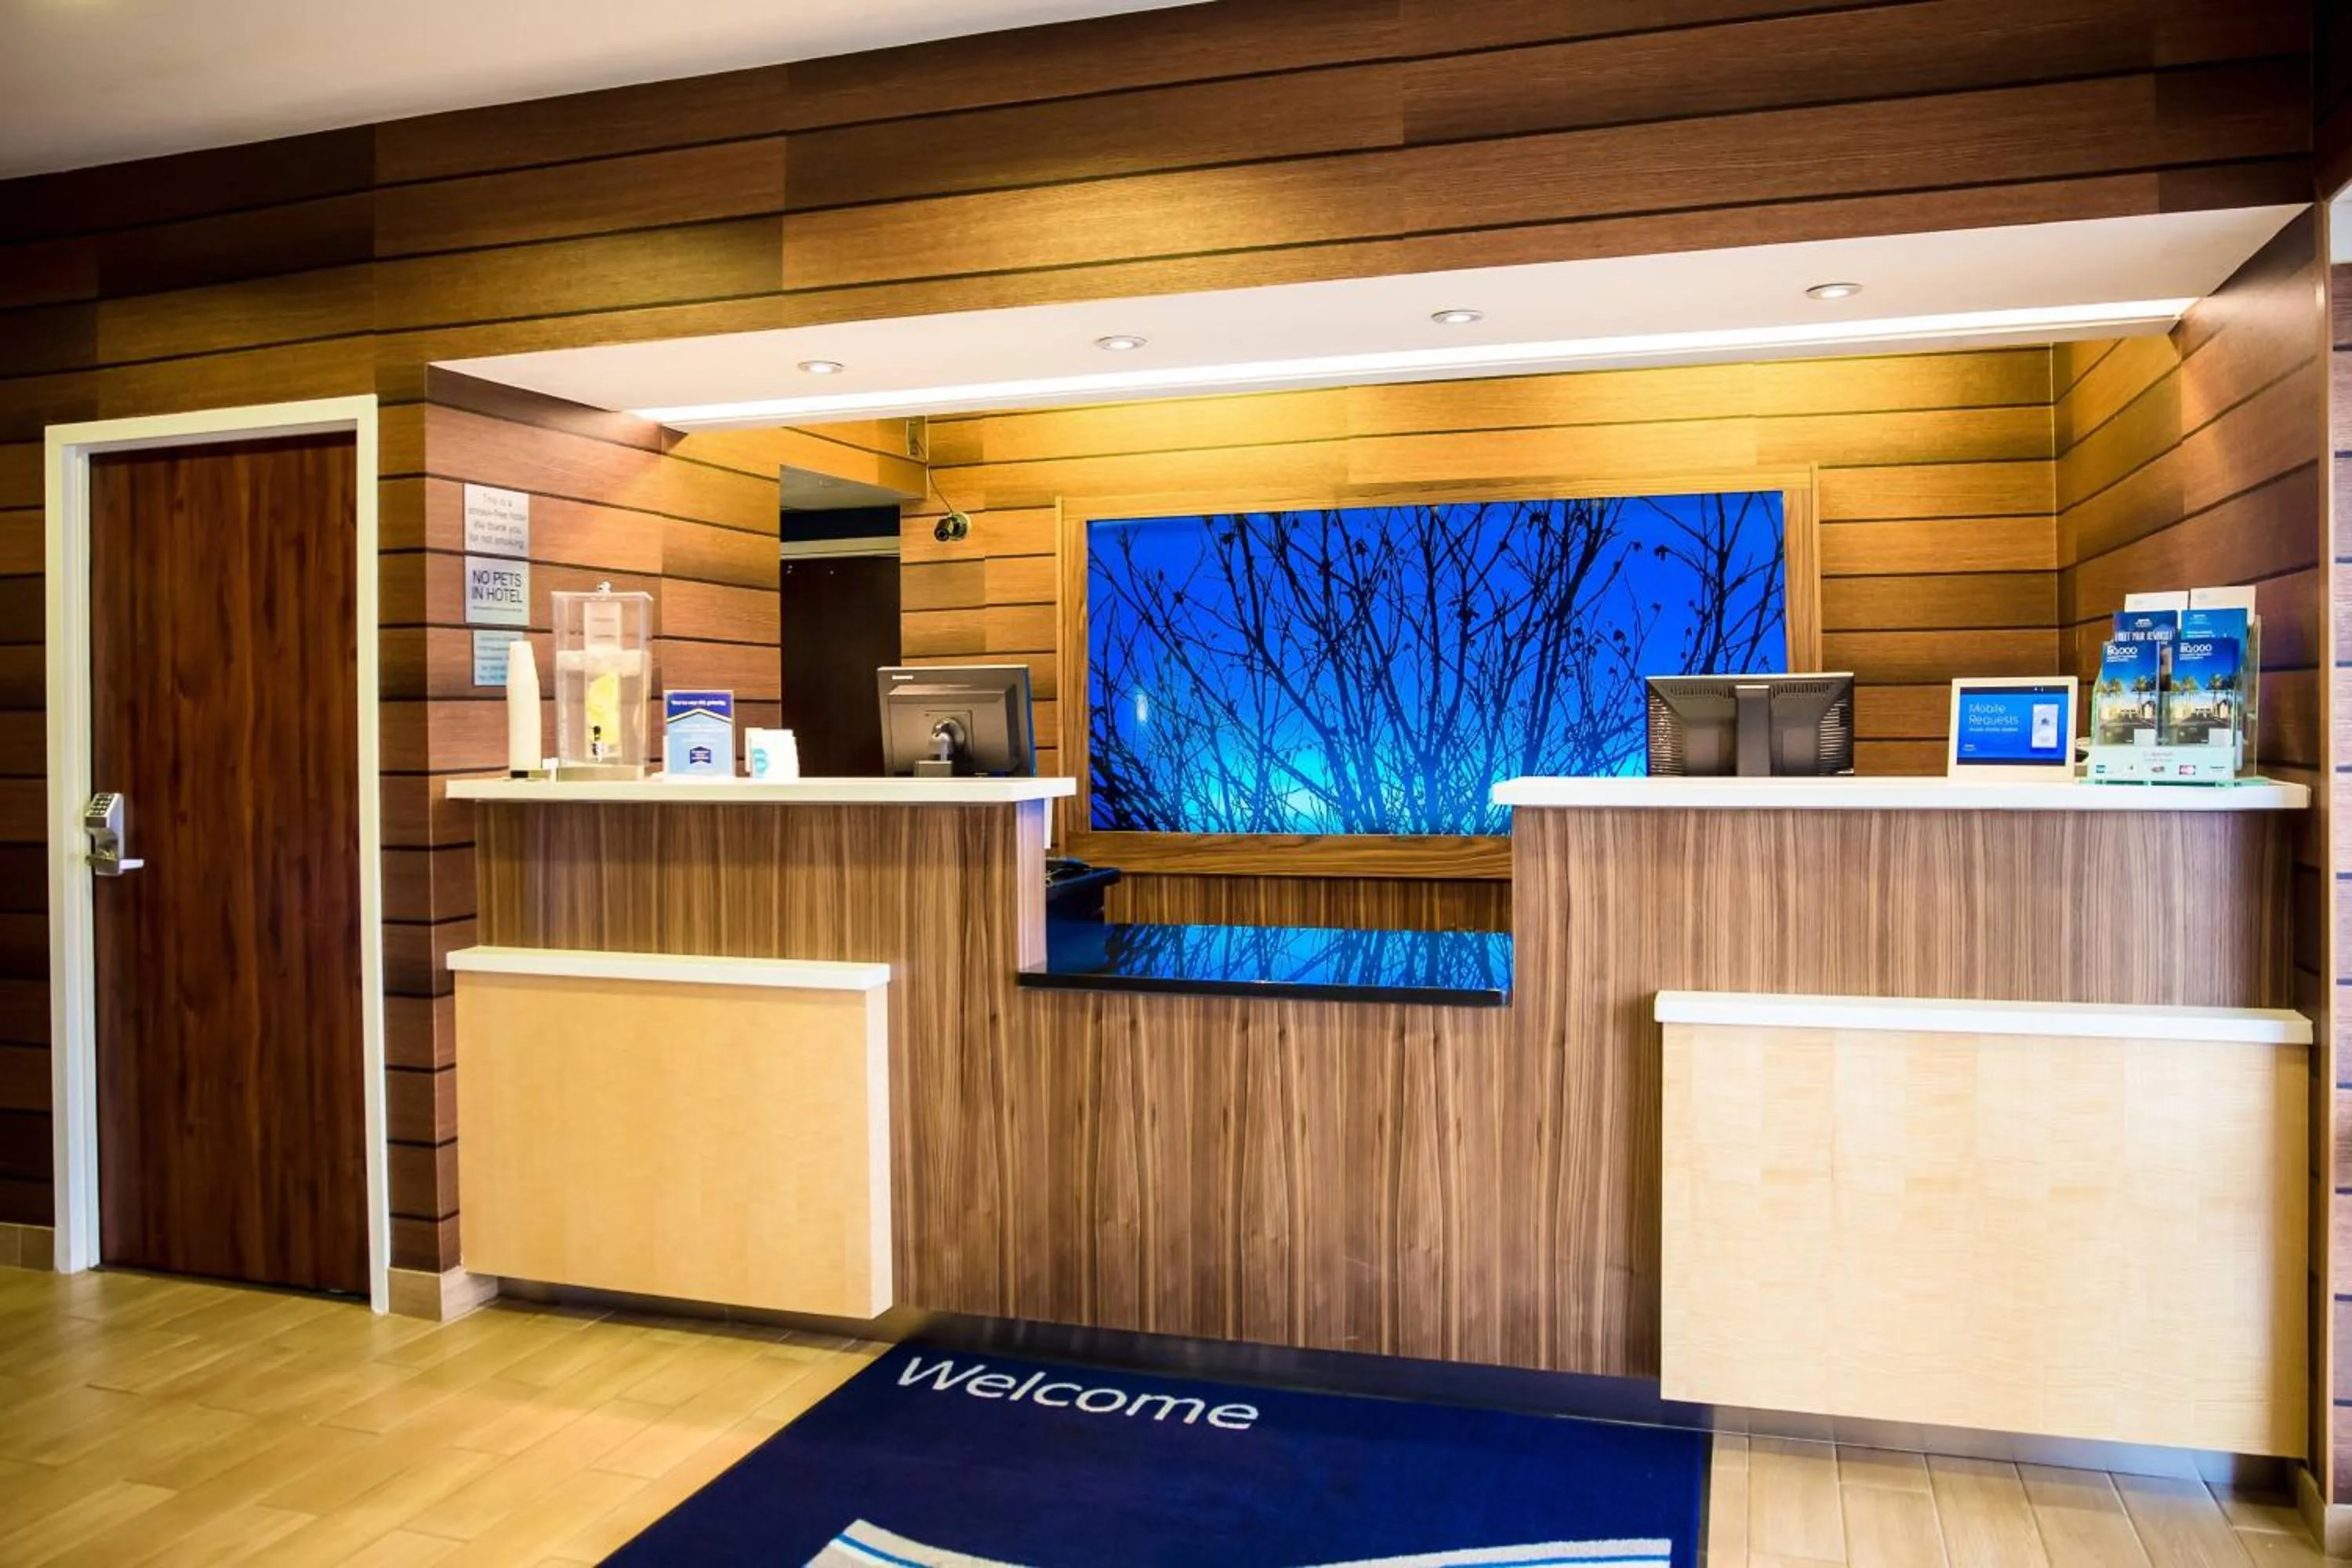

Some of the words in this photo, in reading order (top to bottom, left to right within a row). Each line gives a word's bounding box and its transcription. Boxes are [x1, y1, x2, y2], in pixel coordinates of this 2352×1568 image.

[473, 570, 490, 586] NO
[493, 572, 521, 587] PETS
[471, 586, 484, 601] IN
[487, 587, 523, 603] HOTEL
[1969, 702, 2006, 714] Mobile
[1969, 714, 2020, 726] Requests
[897, 1356, 1259, 1430] Welcome
